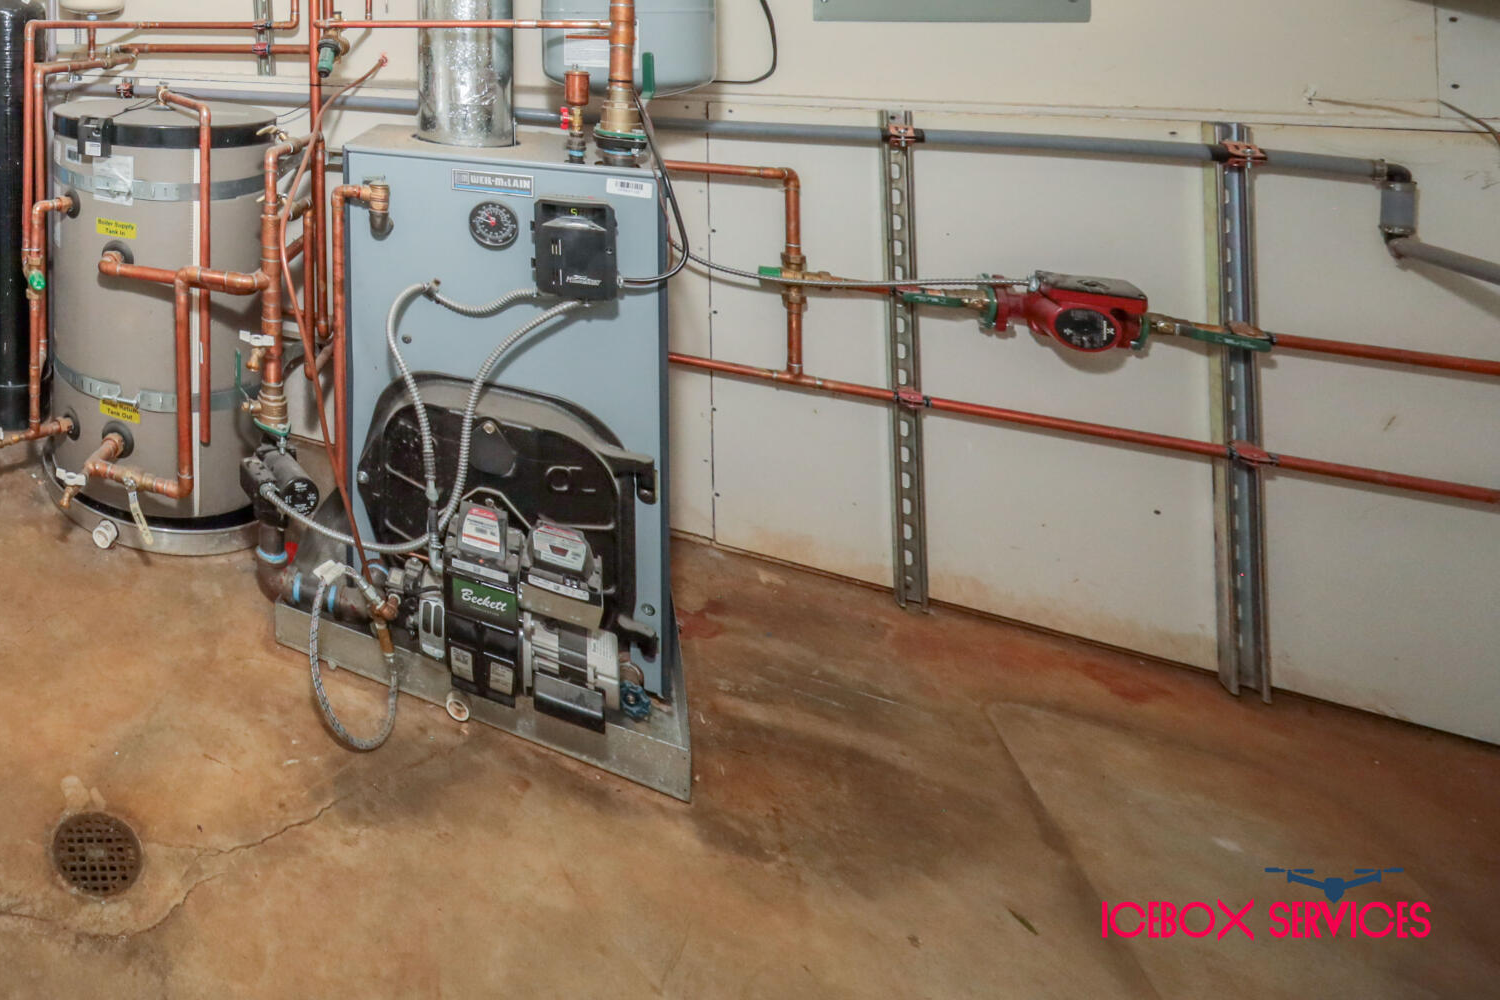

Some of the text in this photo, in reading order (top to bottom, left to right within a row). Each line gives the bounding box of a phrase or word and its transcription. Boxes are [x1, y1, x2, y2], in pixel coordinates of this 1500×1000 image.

[97, 218, 134, 231] Boiler Supply
[105, 227, 118, 236] Tank
[107, 408, 133, 421] Tank Out
[461, 588, 508, 612] Beckett
